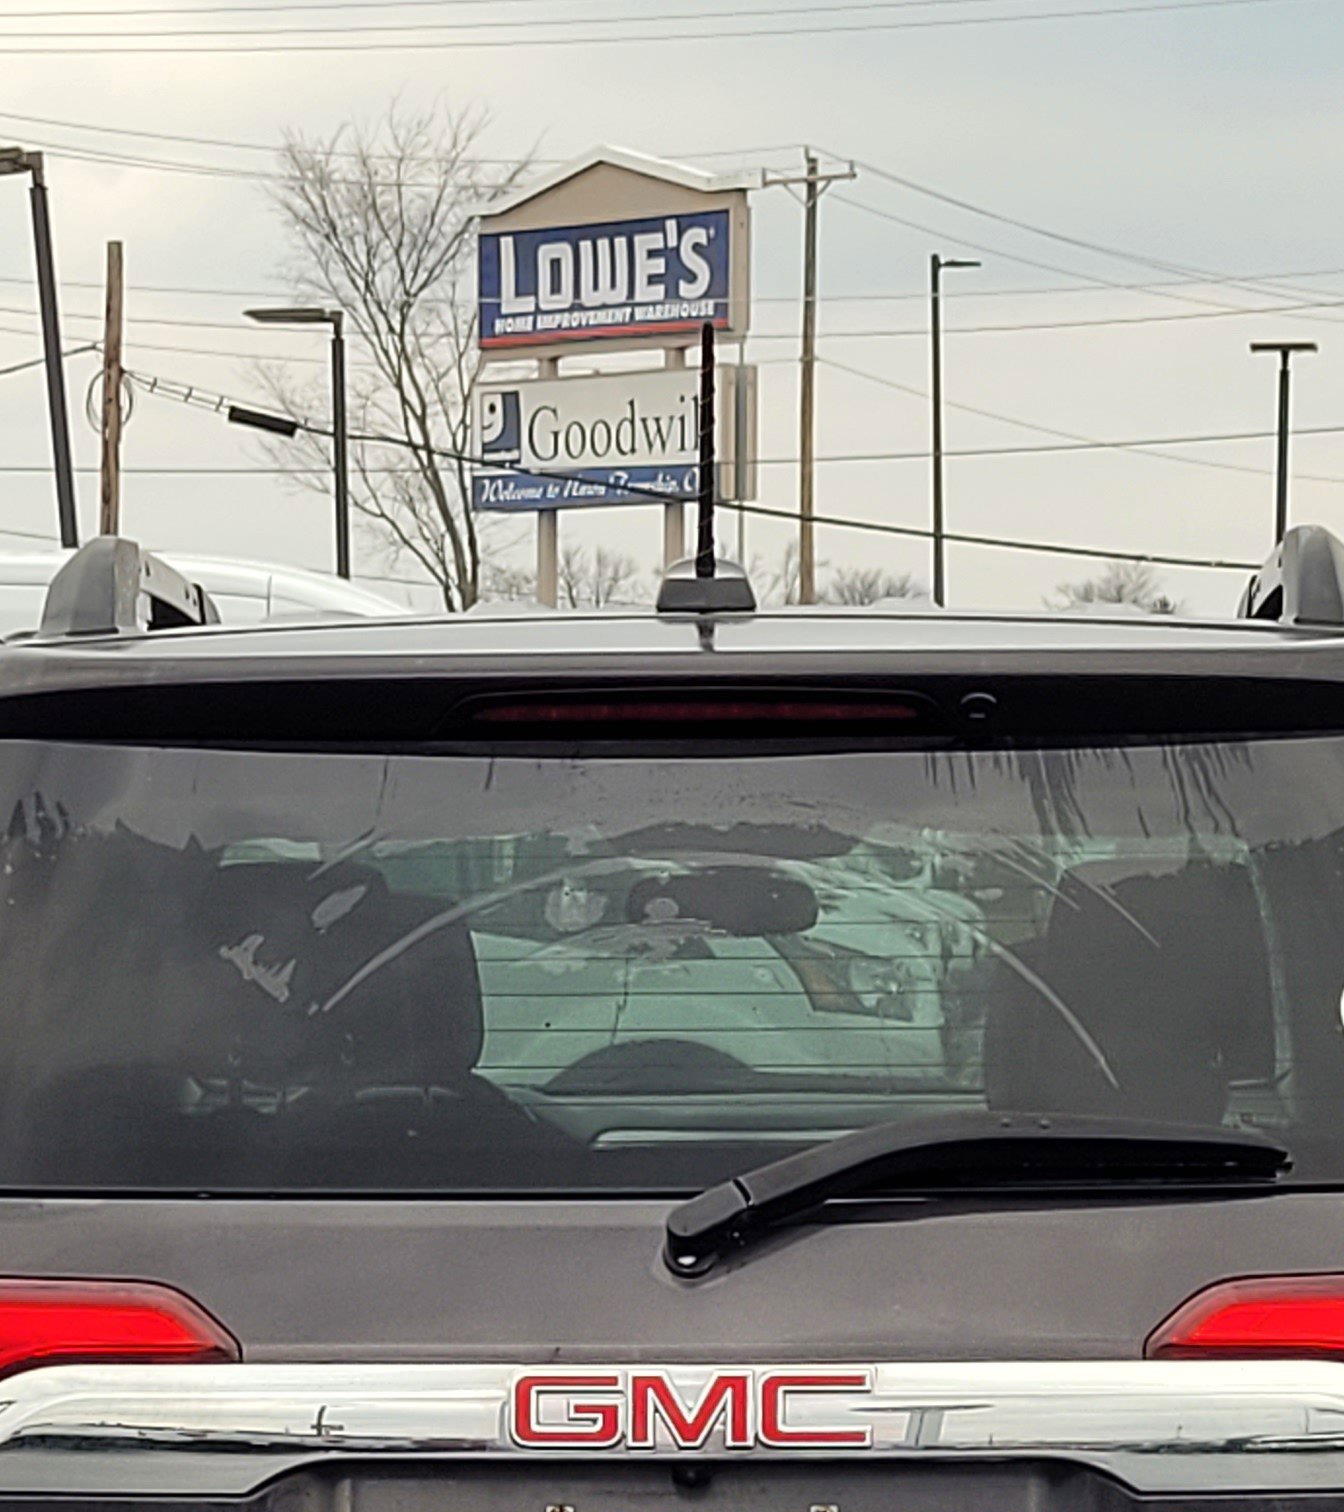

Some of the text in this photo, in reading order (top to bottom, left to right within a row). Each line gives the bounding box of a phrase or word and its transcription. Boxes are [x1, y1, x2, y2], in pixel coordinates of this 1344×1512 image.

[499, 219, 712, 315] LOWE'S
[494, 300, 715, 335] HOME IMPROVEMENT WAREHOUSE
[528, 395, 701, 462] Goodwil
[509, 1366, 874, 1450] GMC
